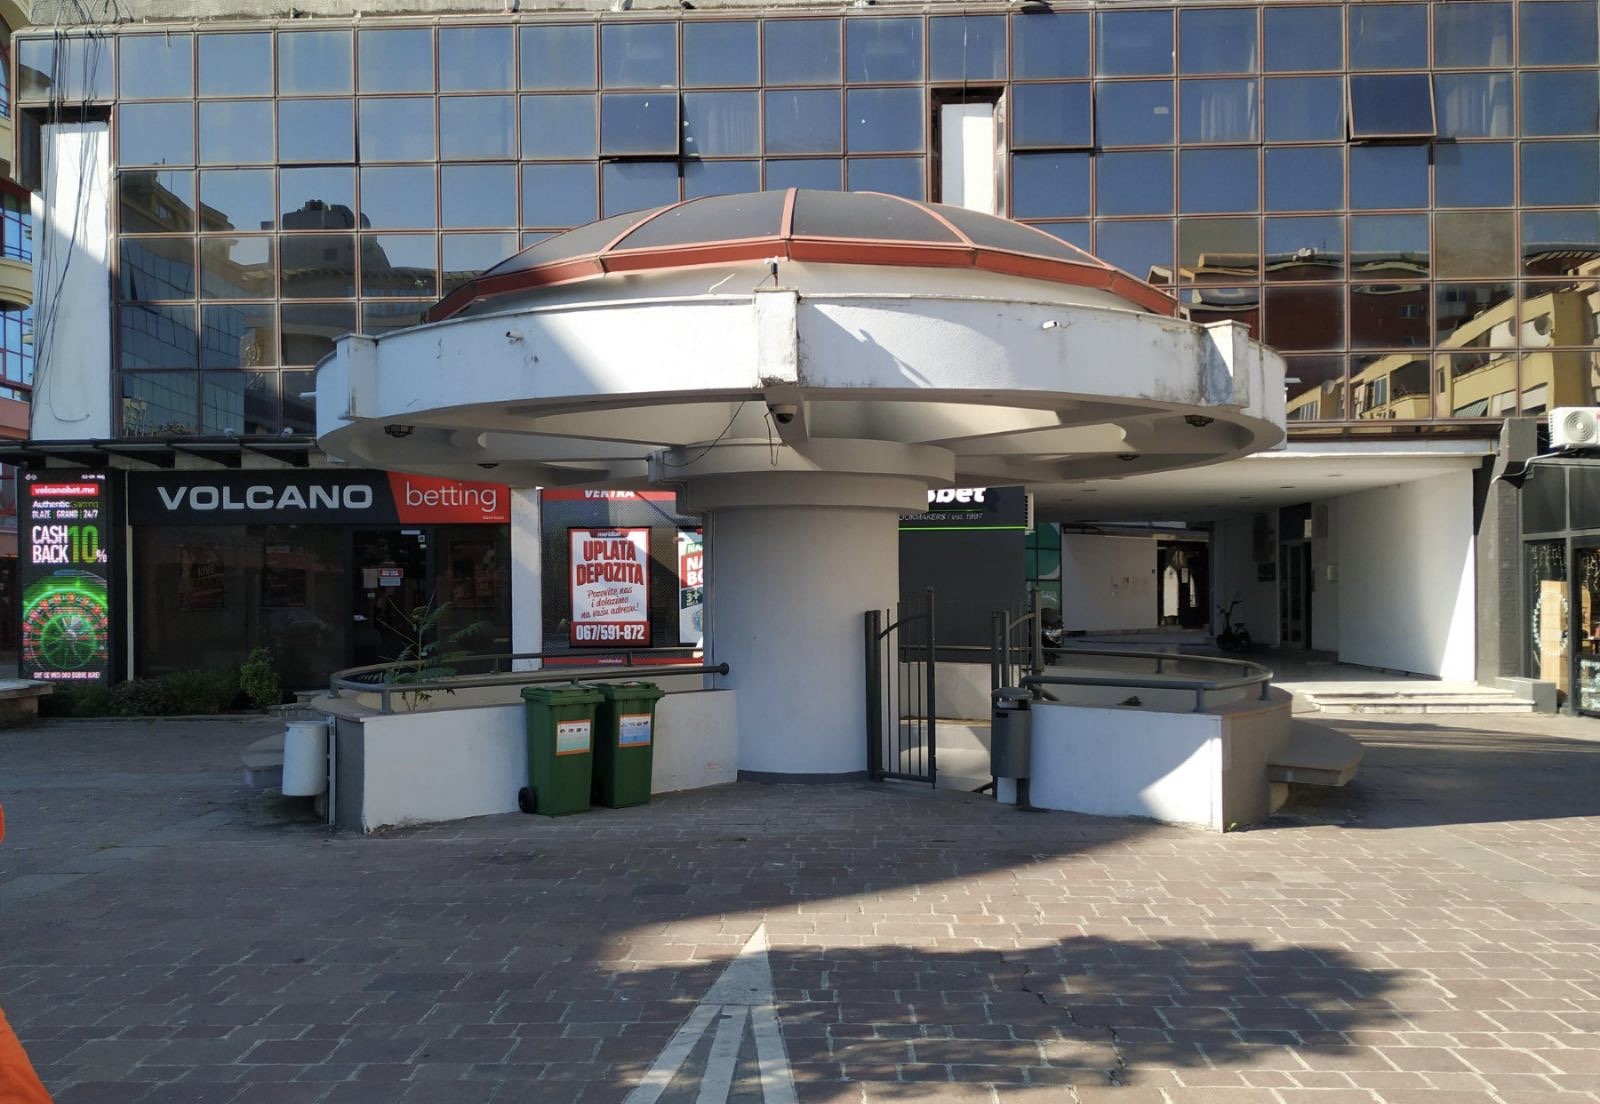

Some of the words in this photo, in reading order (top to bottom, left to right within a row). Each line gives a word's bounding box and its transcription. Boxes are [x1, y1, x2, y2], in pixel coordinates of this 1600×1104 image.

[157, 485, 373, 510] VOLCANO
[406, 481, 496, 512] betting
[32, 525, 68, 544] CASH
[32, 545, 69, 563] BACK
[583, 540, 636, 561] UPLATA
[576, 562, 644, 586] DEPOZITA
[576, 624, 645, 640] 067/591-872
